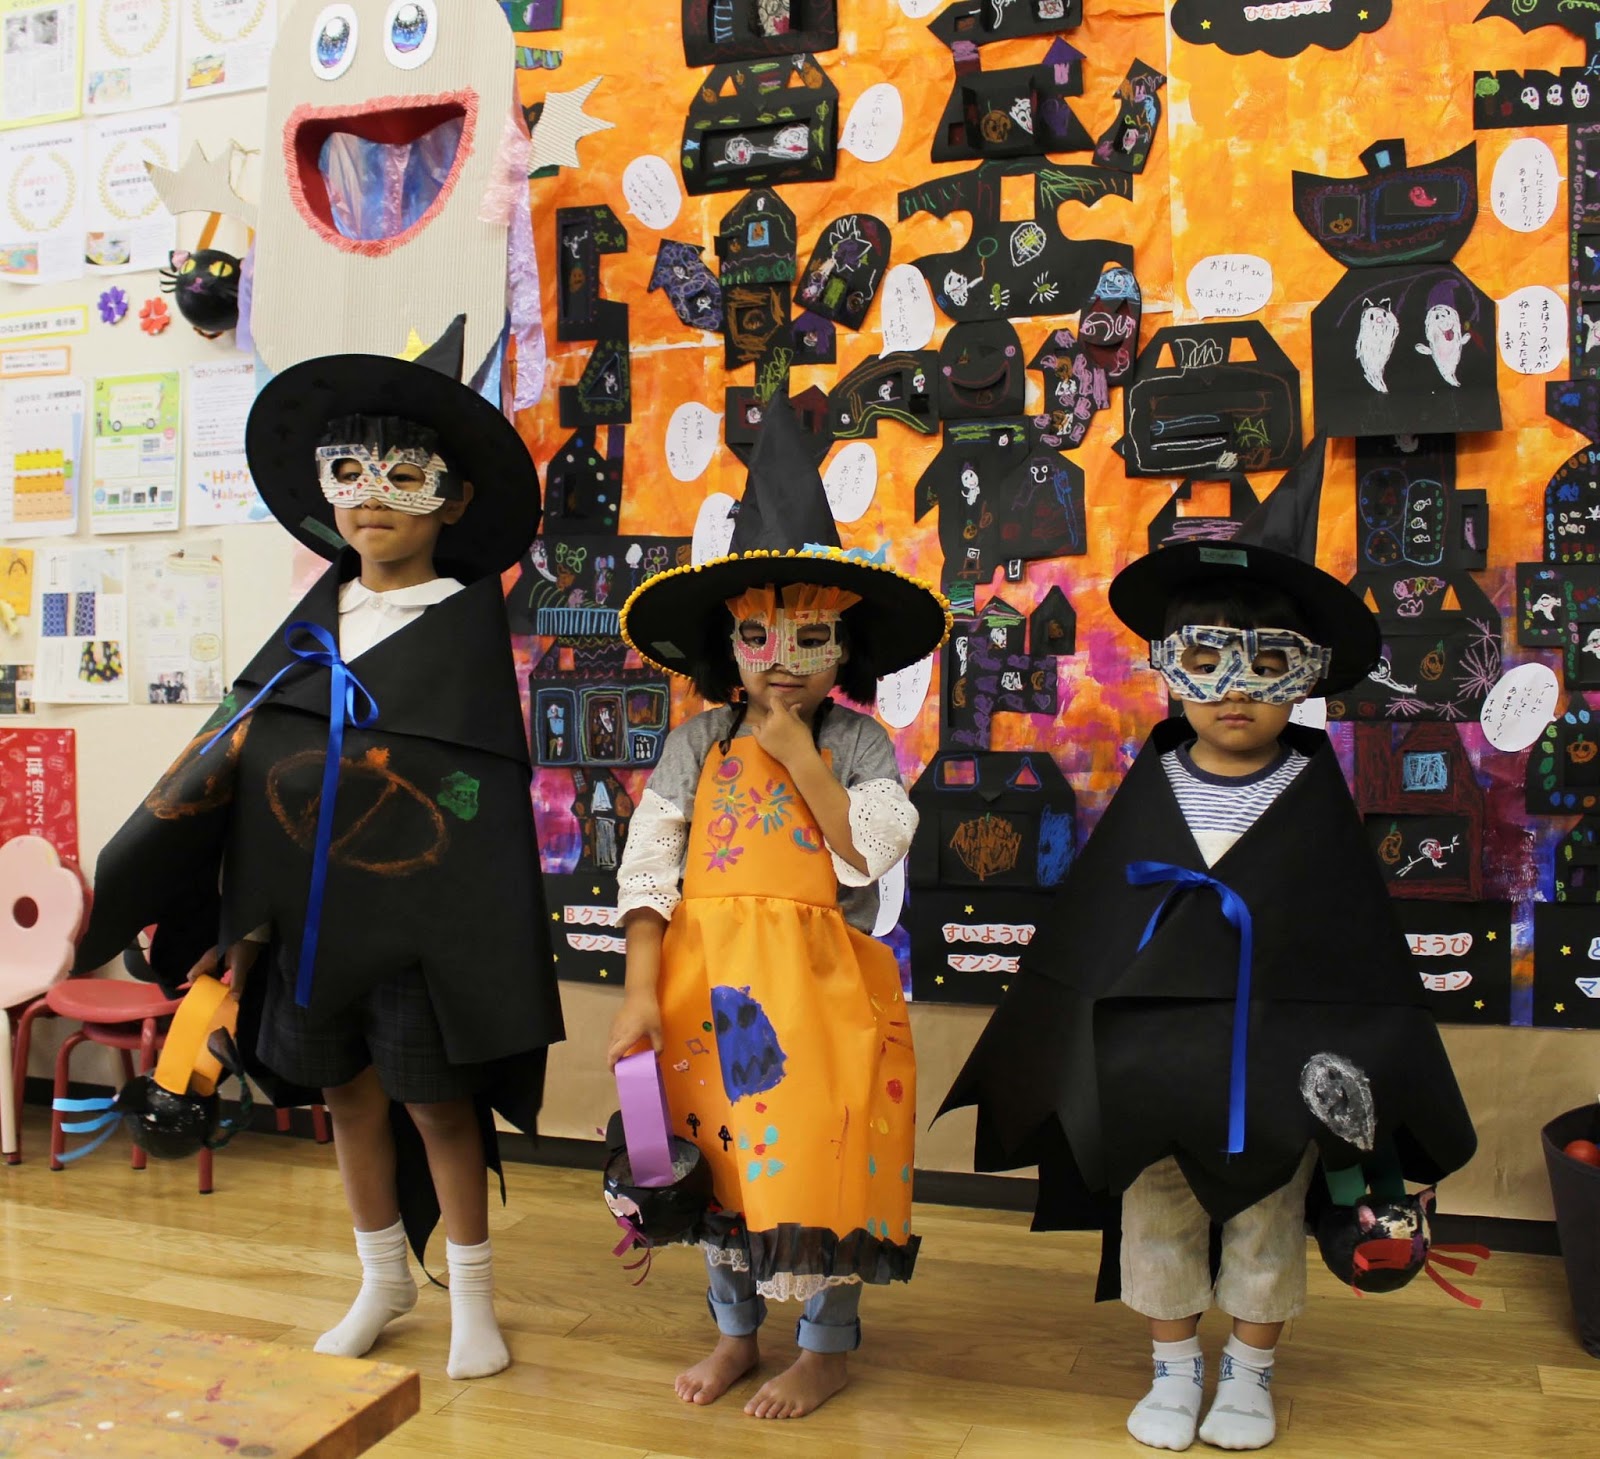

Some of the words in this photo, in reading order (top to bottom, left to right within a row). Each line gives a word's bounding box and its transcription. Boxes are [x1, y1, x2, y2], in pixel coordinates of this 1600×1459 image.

[1247, 1, 1329, 20] ひなたキッズ
[1210, 260, 1265, 278] おすしやさん
[566, 908, 618, 924] Bクラ
[944, 925, 1034, 944] すいようび
[1423, 973, 1470, 990] ョン
